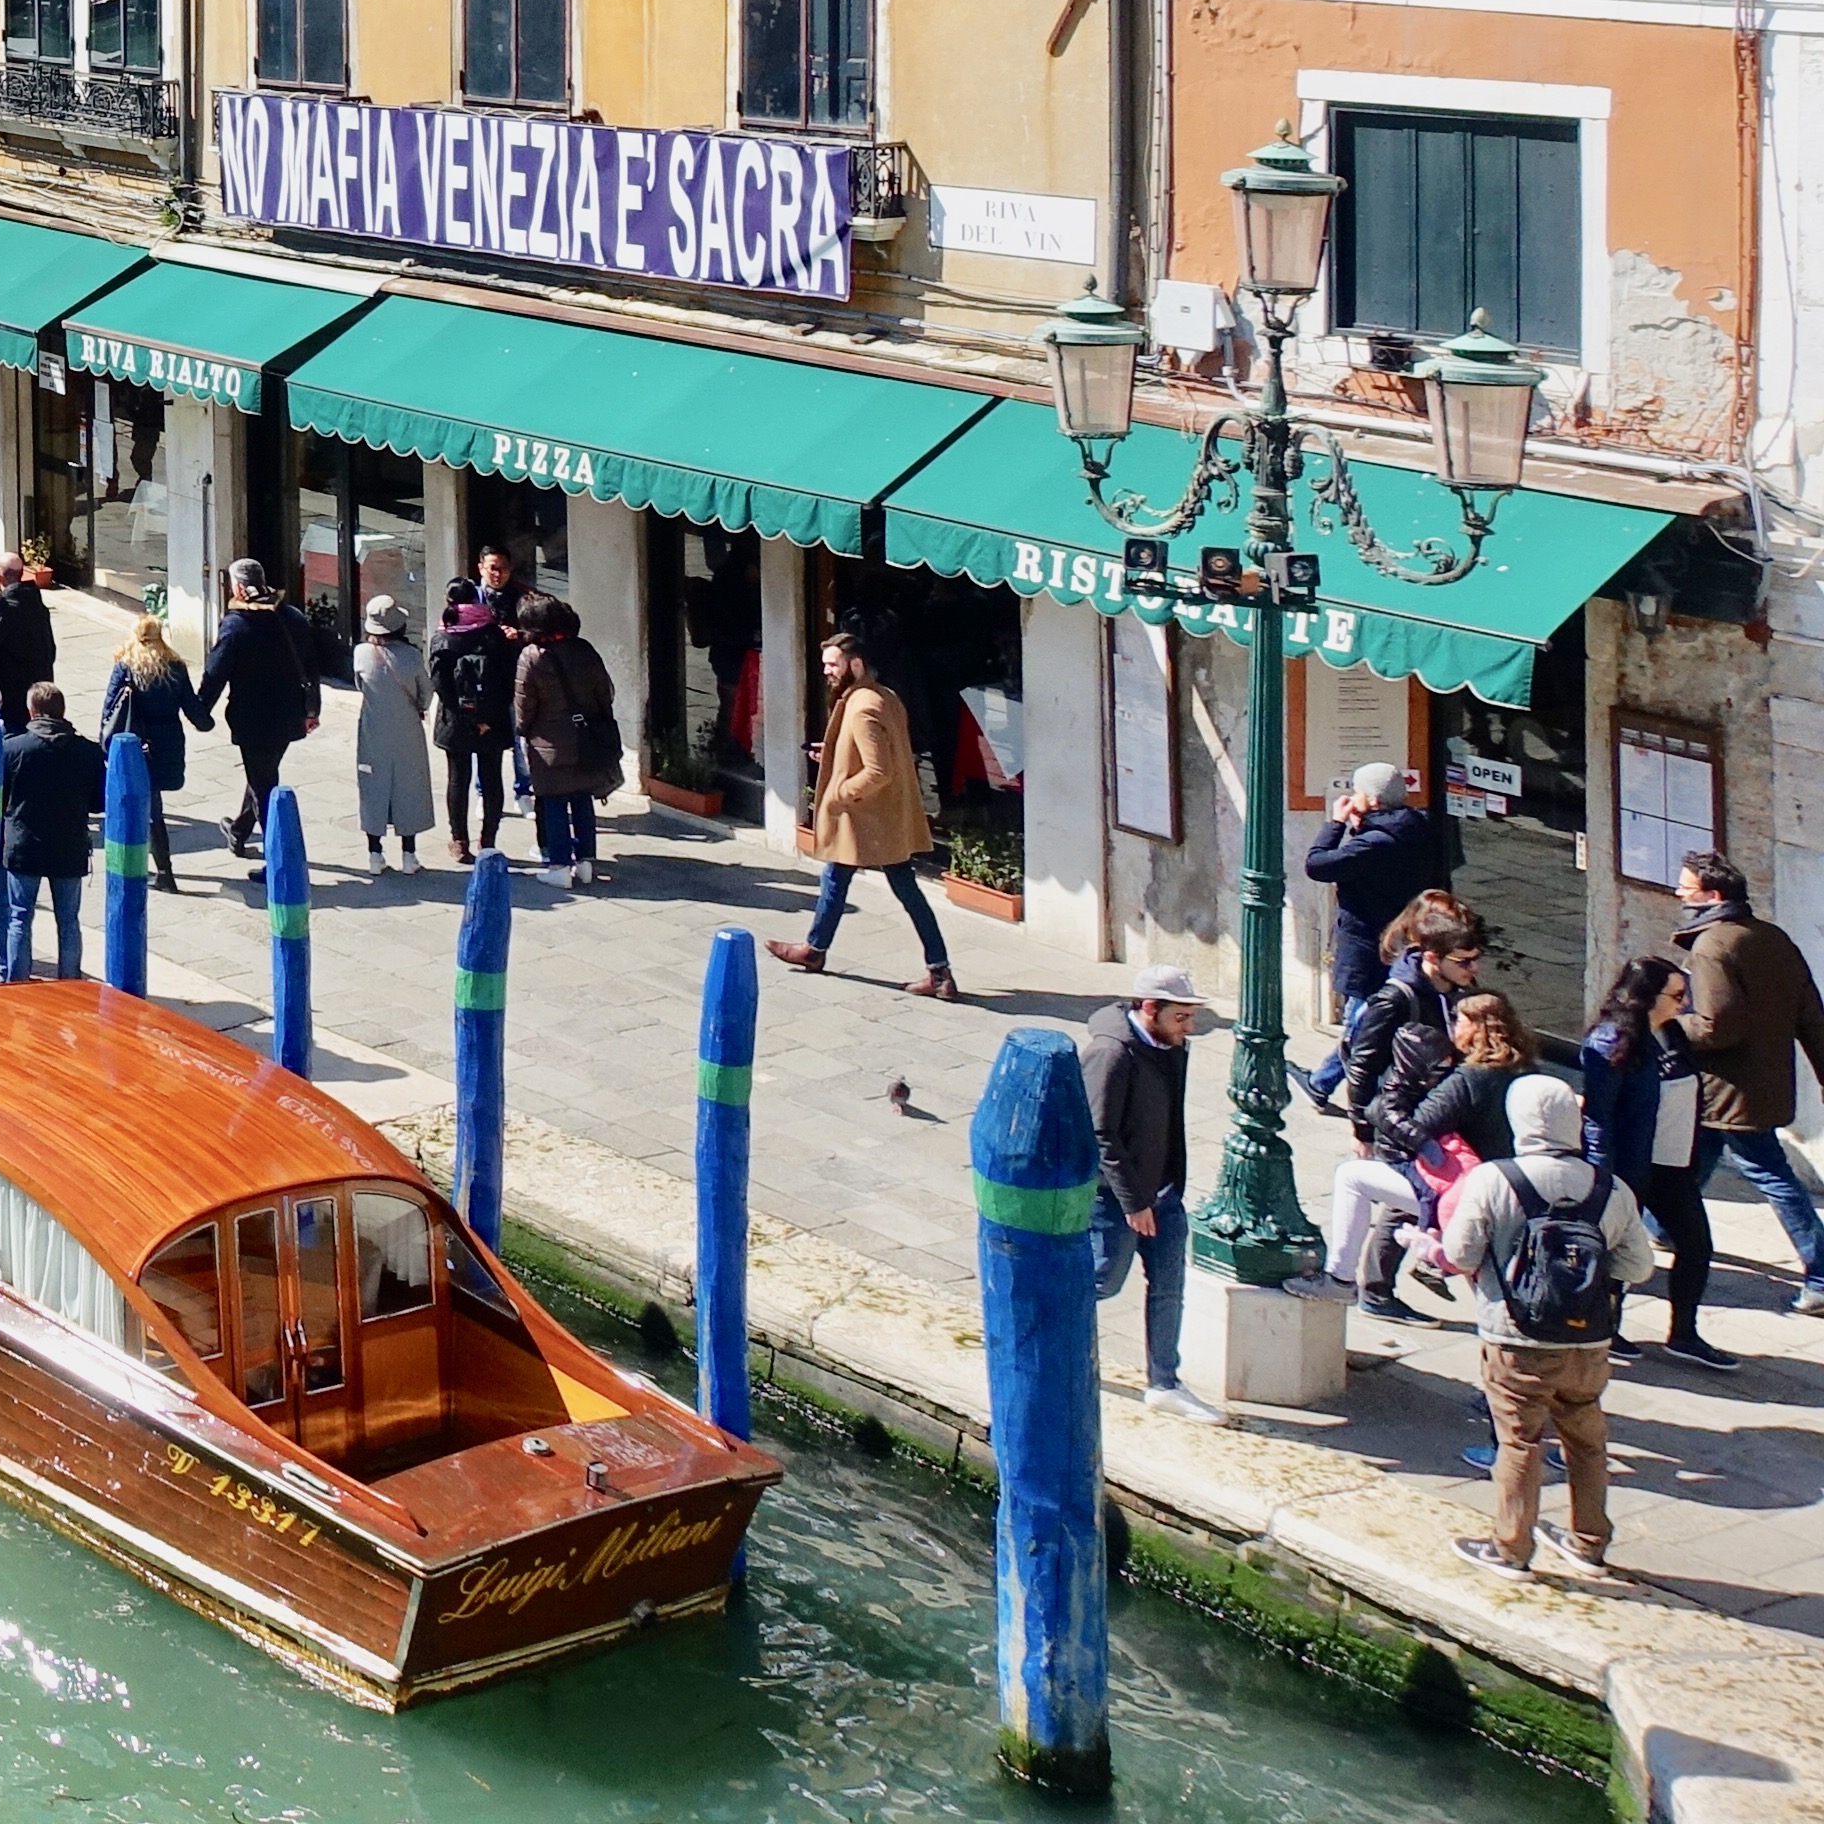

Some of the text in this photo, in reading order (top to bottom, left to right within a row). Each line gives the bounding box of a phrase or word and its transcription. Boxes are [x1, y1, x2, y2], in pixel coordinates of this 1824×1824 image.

[221, 96, 269, 219] NO
[276, 100, 402, 236] MAFIA
[416, 113, 606, 265] VENEZIA
[668, 134, 846, 295] SACRA
[985, 200, 1037, 223] RIVA
[961, 223, 1063, 252] DEL VIN
[81, 335, 136, 373] RIVA
[149, 349, 242, 397] RIALTO
[492, 433, 595, 486] PIZZA
[1472, 765, 1512, 785] OPEN
[209, 1474, 322, 1548] 13317
[438, 1546, 578, 1624] Luigi
